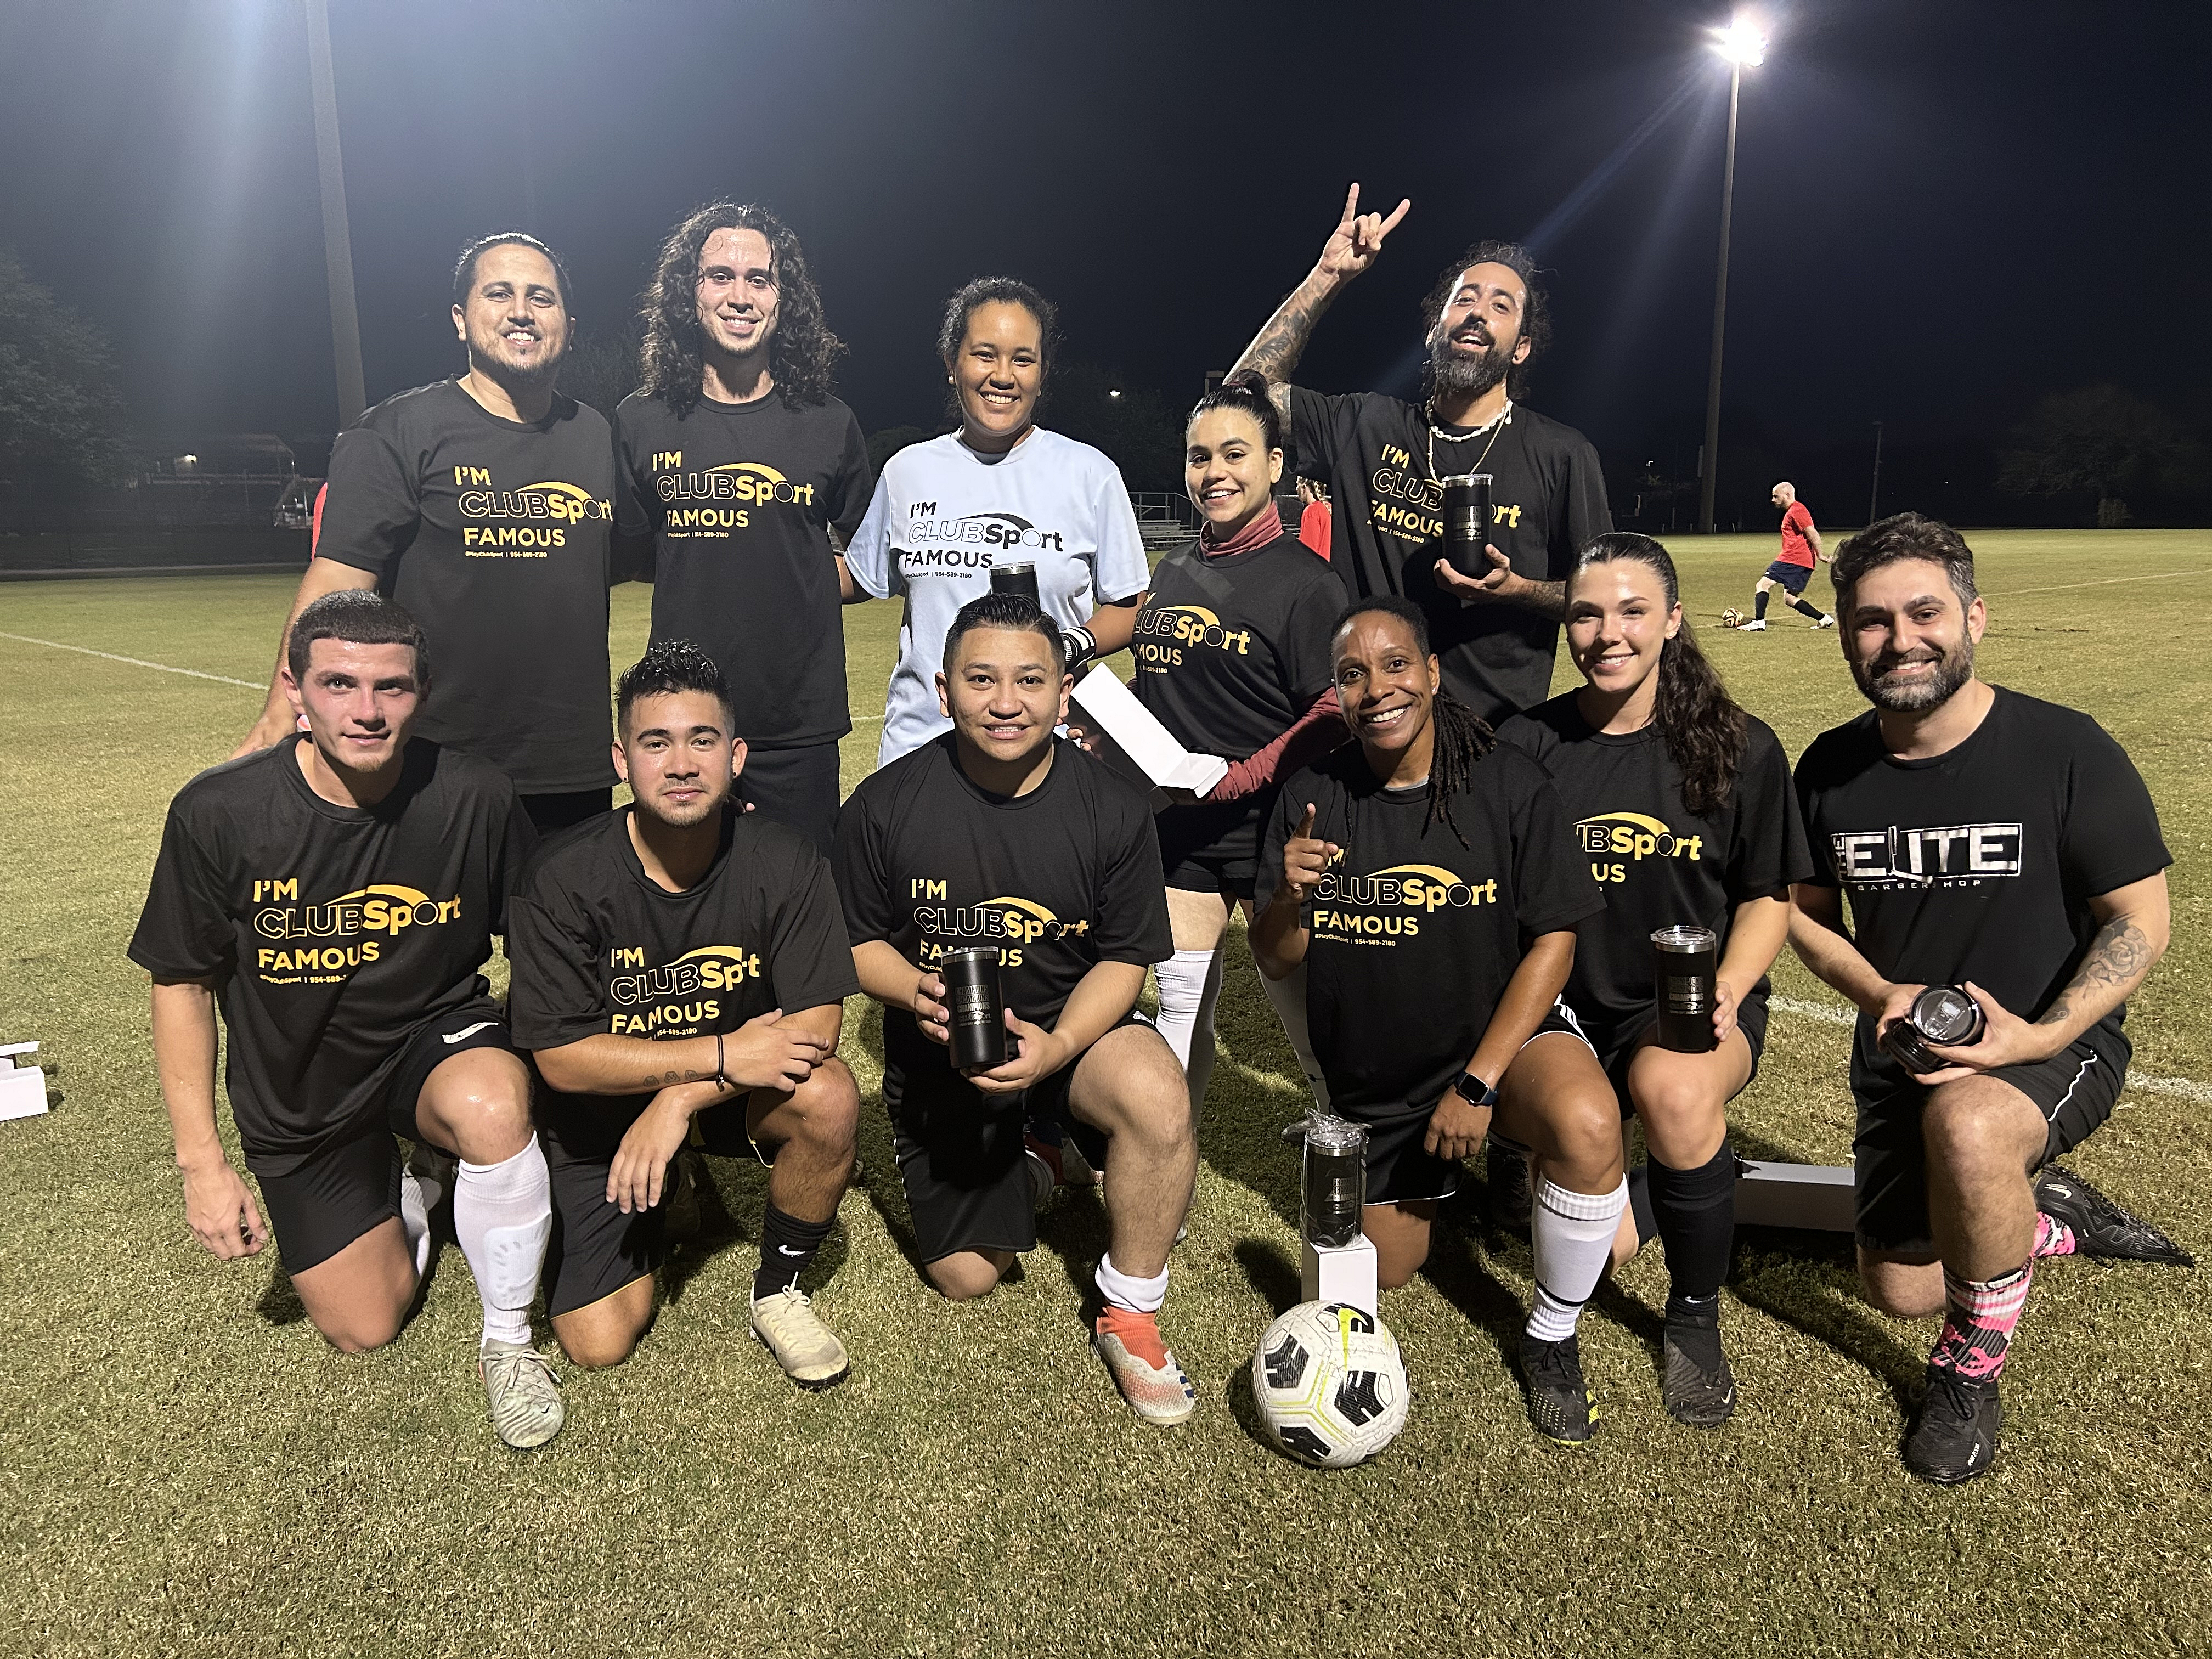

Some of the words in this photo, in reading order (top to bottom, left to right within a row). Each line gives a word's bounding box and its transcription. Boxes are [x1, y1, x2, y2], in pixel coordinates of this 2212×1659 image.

[653, 450, 681, 471] I'M
[1381, 444, 1410, 469] I'M
[454, 466, 492, 486] I'M
[657, 473, 814, 506] CLUBSport
[459, 490, 613, 524] CLUBSport
[910, 501, 937, 518] I'M
[464, 527, 566, 546] FAMOUS
[909, 520, 1064, 552] CLUBSport
[905, 550, 993, 568] FAMOUS
[1133, 610, 1250, 655] LUBSport
[253, 878, 298, 902] I'M
[911, 879, 947, 900] I'M
[1314, 873, 1497, 912] CLUBSport
[254, 894, 461, 939] CLUBSport
[914, 906, 1089, 944] CLUBSport
[1314, 911, 1419, 935] FAMOUS
[258, 941, 380, 972] FAMOUS
[611, 947, 645, 969] I'M
[611, 1000, 720, 1034] FAMOUS
